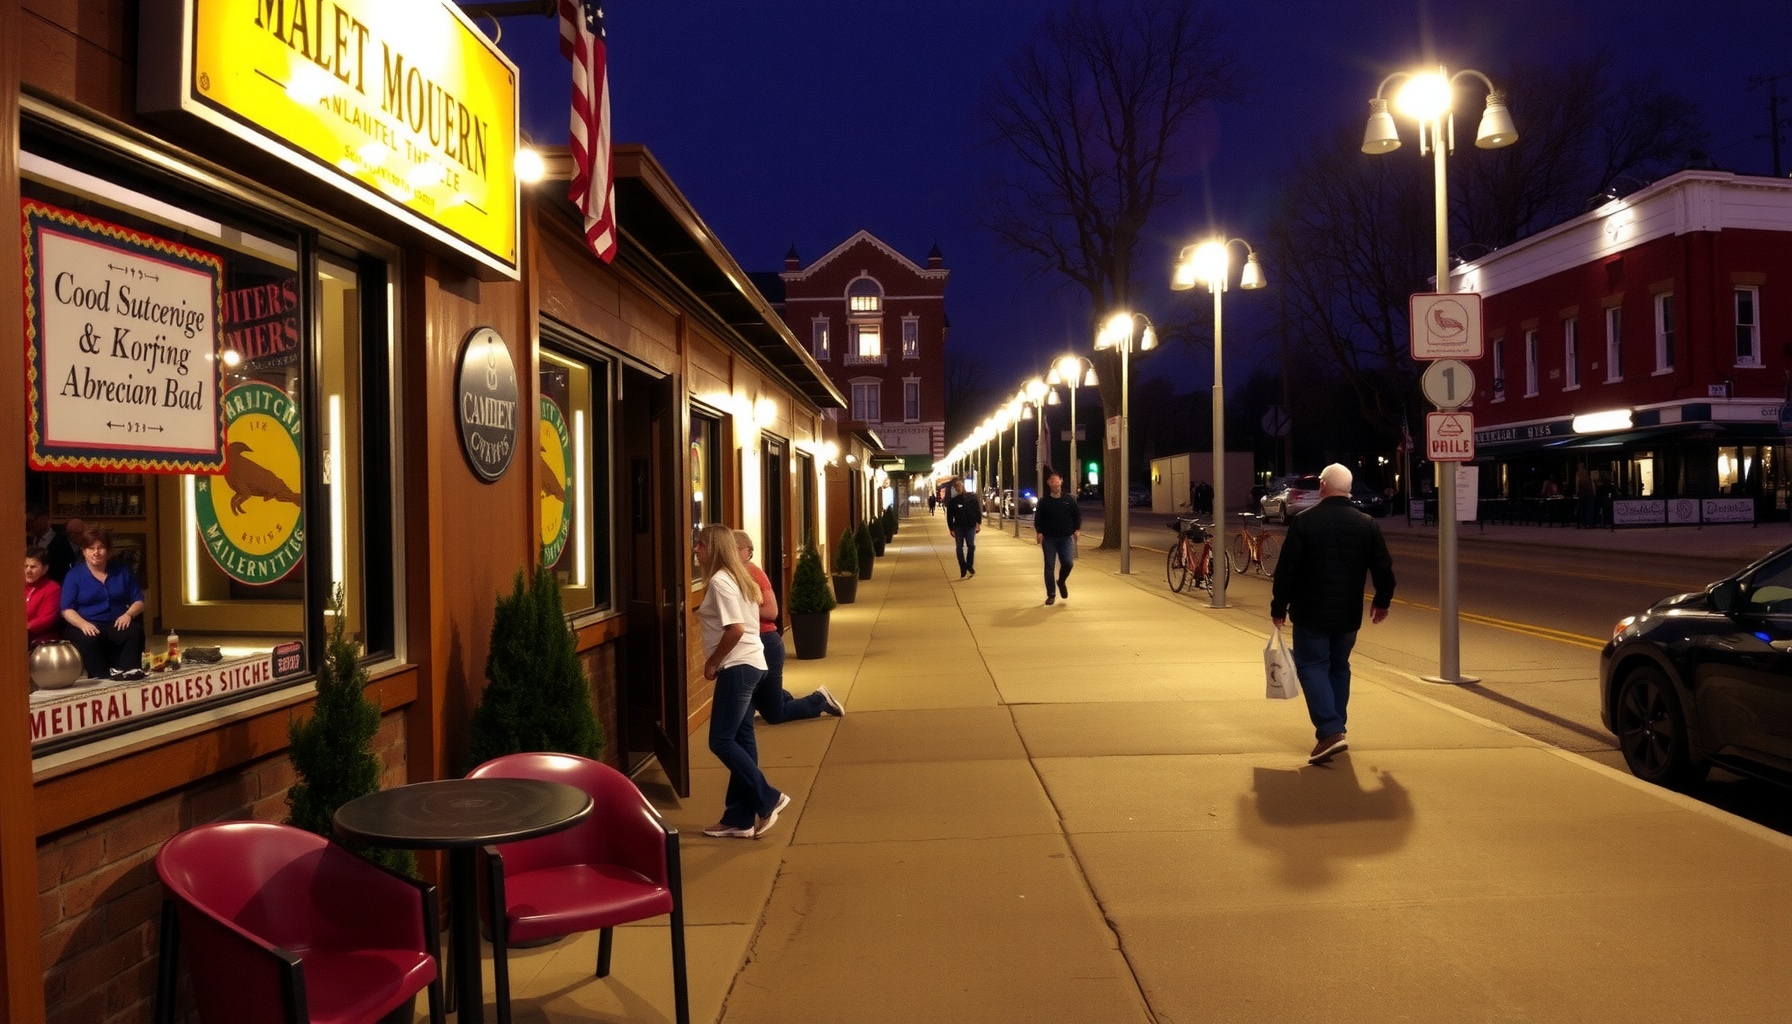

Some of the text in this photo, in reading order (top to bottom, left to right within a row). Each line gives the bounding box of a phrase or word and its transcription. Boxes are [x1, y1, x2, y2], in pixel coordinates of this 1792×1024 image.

[79, 322, 101, 355] &
[60, 364, 203, 411] Abrecian Bad
[1442, 366, 1455, 401] 1
[141, 673, 213, 712] FORLESS
[220, 660, 271, 692] SITCHE
